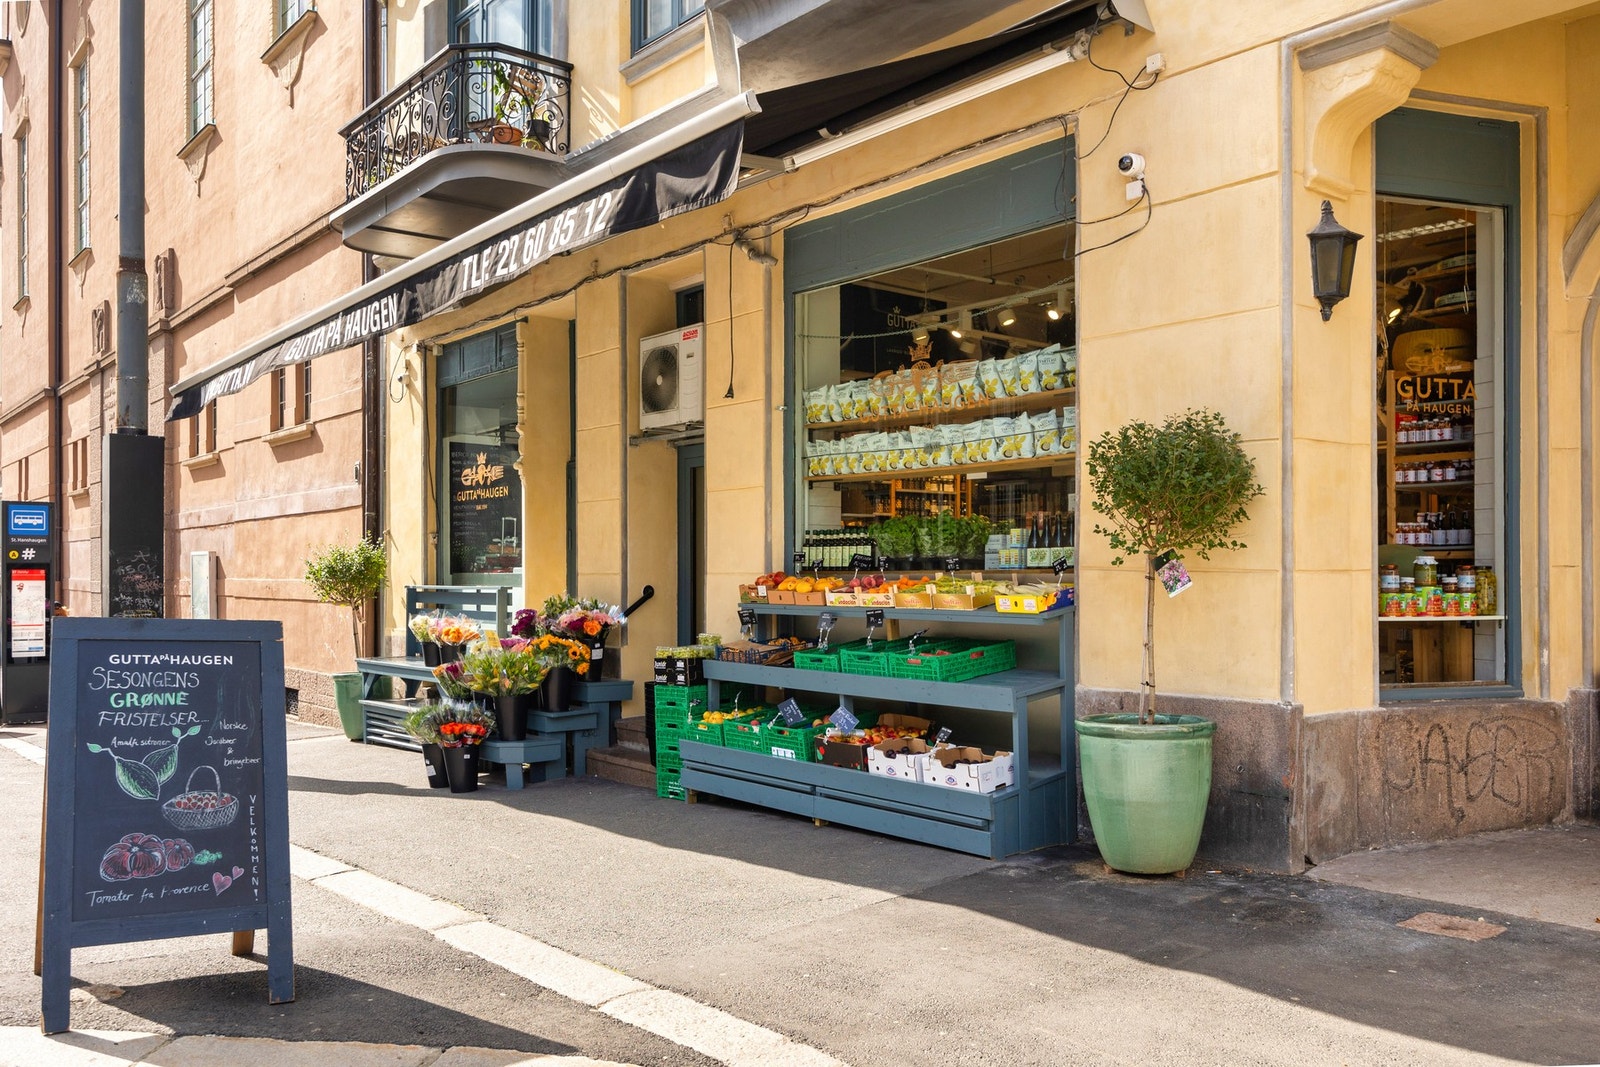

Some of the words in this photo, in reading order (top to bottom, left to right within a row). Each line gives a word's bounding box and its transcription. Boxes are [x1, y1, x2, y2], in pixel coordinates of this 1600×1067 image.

[462, 246, 492, 291] TLF.
[495, 235, 520, 280] 22
[522, 222, 547, 265] 60
[548, 207, 579, 252] 85
[584, 192, 612, 237] 12
[285, 329, 324, 361] GUTTA
[324, 312, 343, 348] PÅ
[343, 293, 399, 341] HAUGEN
[1396, 375, 1477, 400] GUTTA
[859, 406, 909, 423] GUTTA
[918, 394, 990, 415] HAUGEN
[1406, 400, 1420, 412] PÅ
[1423, 403, 1471, 414] HAUGEN
[457, 489, 478, 502] GUTTA
[481, 486, 509, 499] HAUGEN
[109, 654, 161, 665] GUTTA
[160, 653, 170, 661] PÅ
[170, 655, 233, 665] HAUGEN
[88, 667, 200, 690] SESONGENS
[109, 691, 190, 709] GRØNNE
[219, 719, 249, 731] Norske
[227, 747, 234, 755] &
[249, 794, 260, 902] VELKOMMEN!
[85, 890, 134, 907] Tomater
[140, 888, 154, 903] fra
[160, 883, 210, 899] Povence
